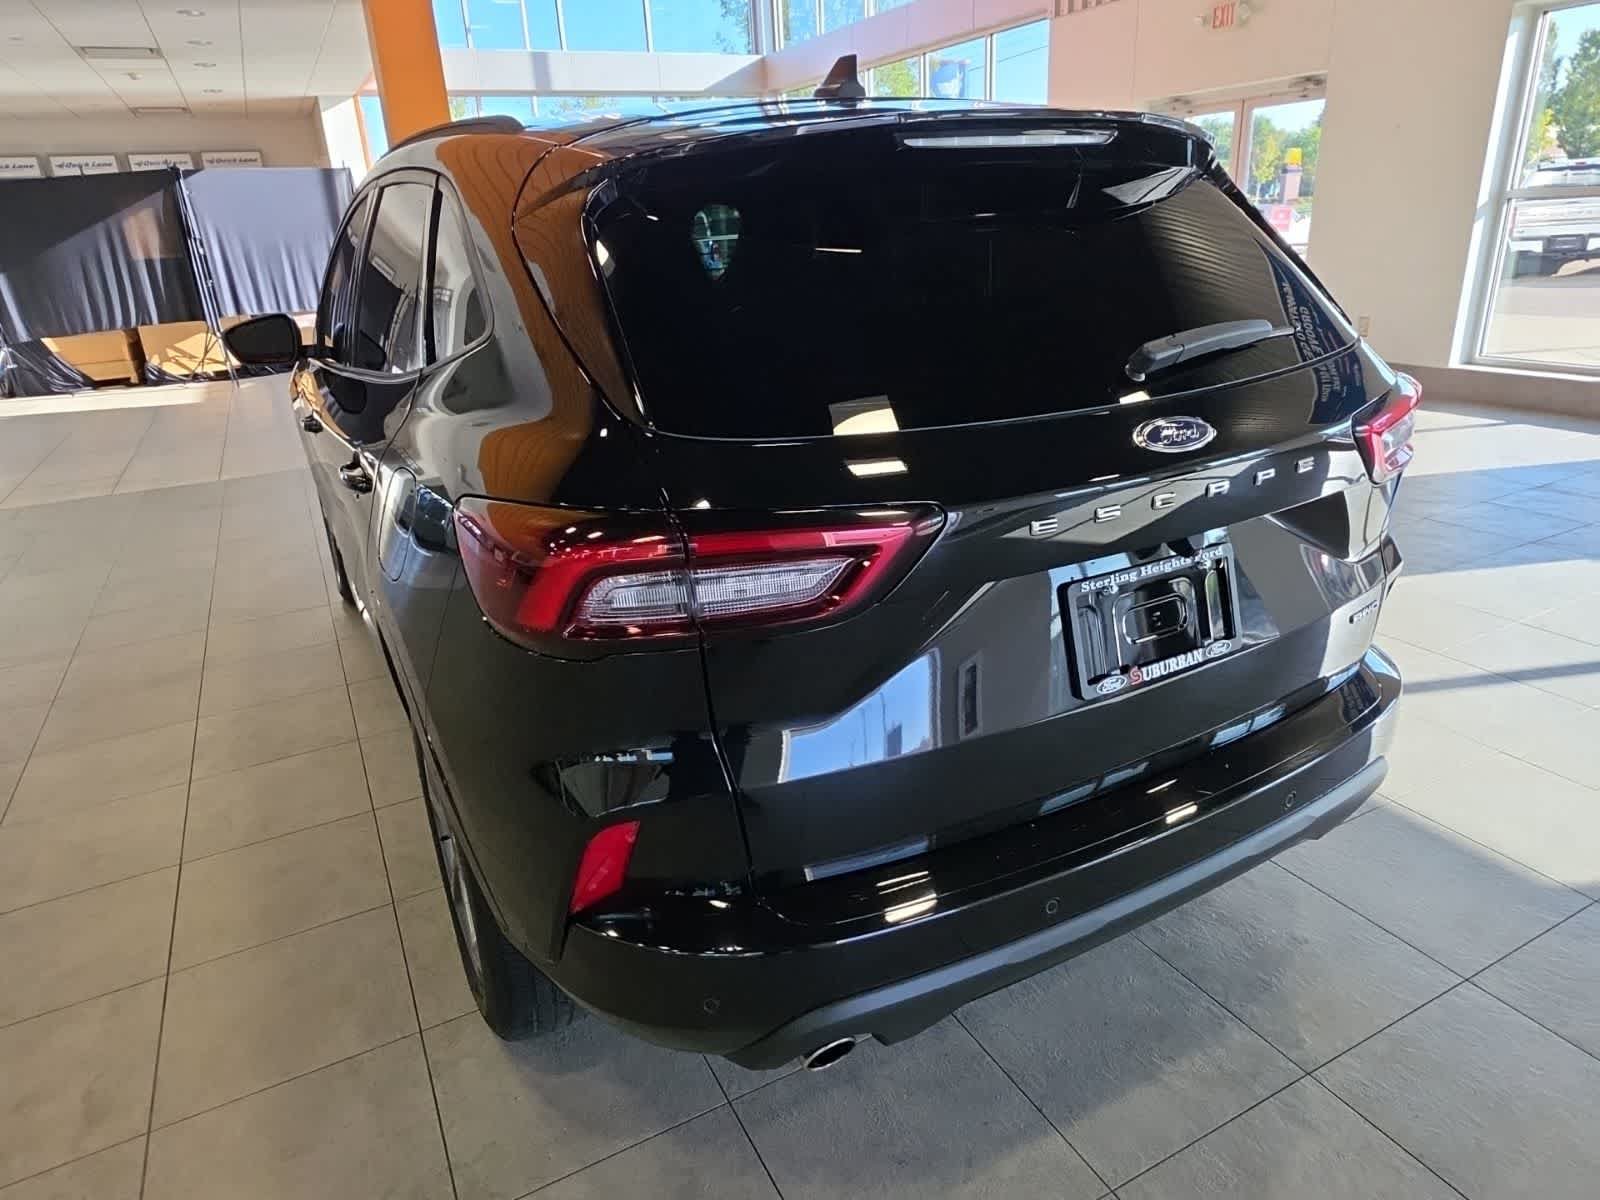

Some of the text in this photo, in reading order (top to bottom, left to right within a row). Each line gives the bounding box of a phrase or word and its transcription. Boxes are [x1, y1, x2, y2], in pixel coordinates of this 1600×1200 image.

[1212, 3, 1236, 29] EXIT
[1029, 456, 1315, 537] ESCAPE
[1081, 546, 1224, 593] Sterling Heights Ford
[1130, 648, 1204, 686] SUBURBAN
